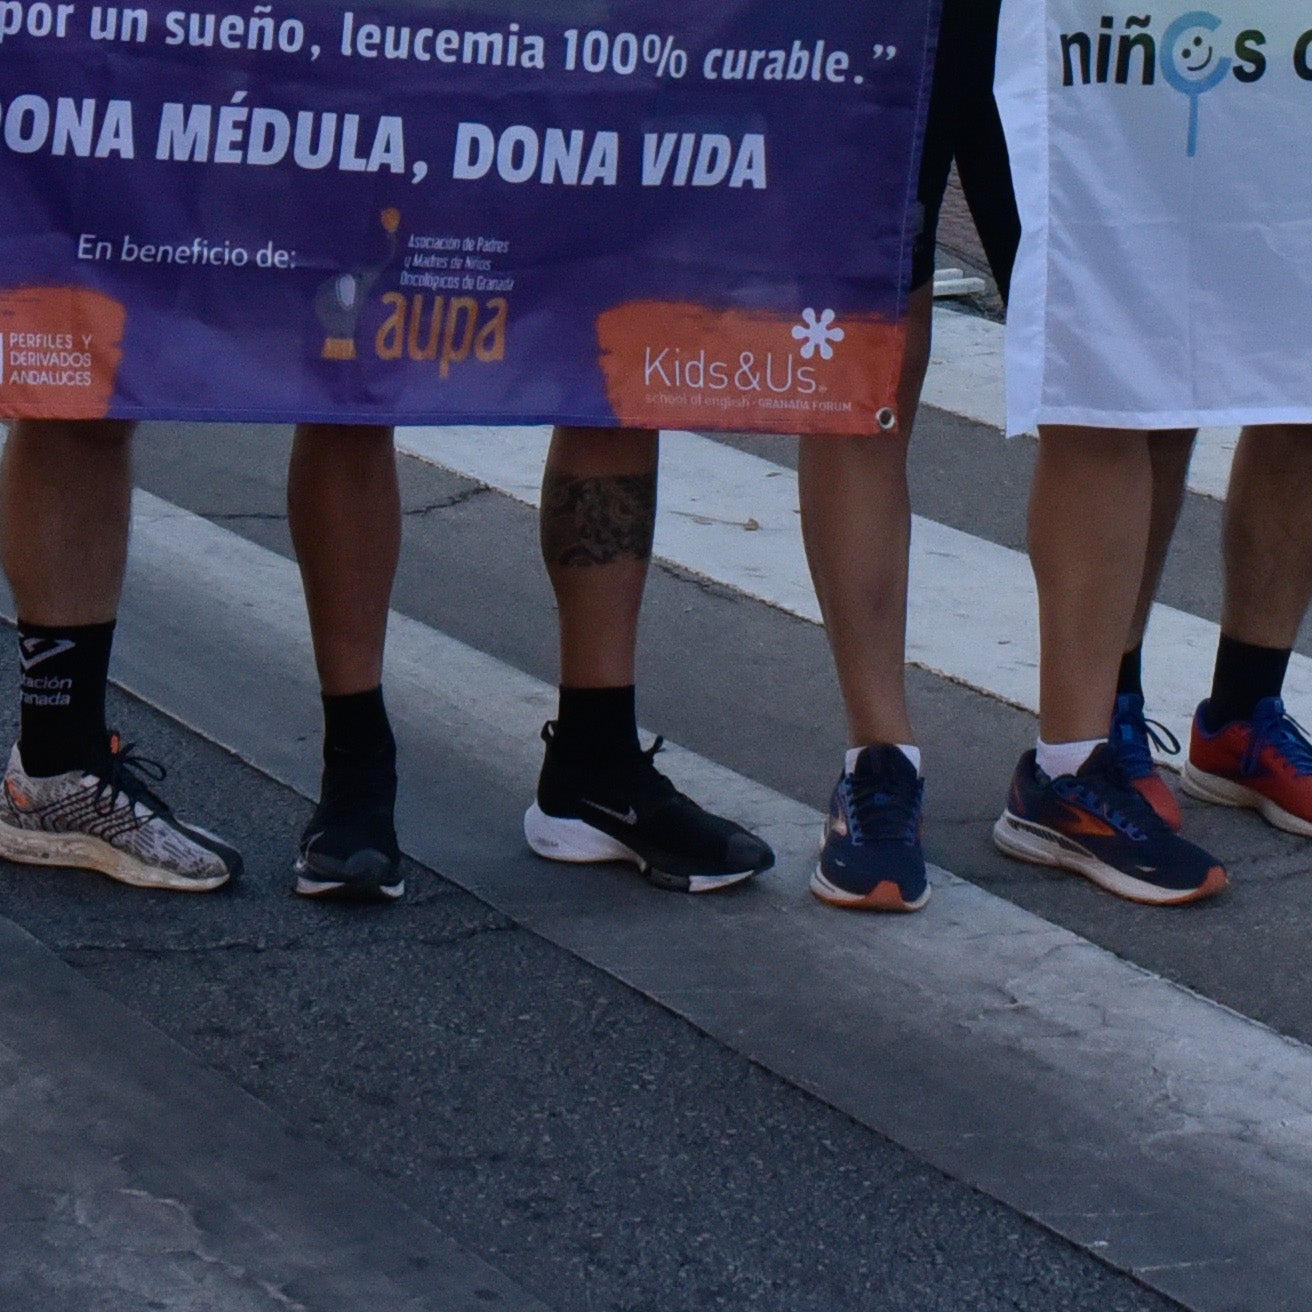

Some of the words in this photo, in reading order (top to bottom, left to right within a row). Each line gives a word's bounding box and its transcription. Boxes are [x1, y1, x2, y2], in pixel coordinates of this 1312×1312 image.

[90, 6, 148, 43] un
[165, 4, 321, 62] sueño,
[341, 11, 544, 70] leucemia
[563, 26, 687, 79] 100%
[156, 90, 429, 184] MÉDULA,
[452, 120, 619, 186] DONA
[641, 130, 767, 190] VIDA
[77, 234, 112, 262] En
[121, 235, 248, 268] beneficio
[256, 240, 296, 270] de:
[408, 234, 460, 251] Asociación
[462, 237, 475, 251] de
[476, 237, 510, 254] Padres
[412, 252, 448, 269] Madres
[450, 255, 463, 269] de
[462, 274, 475, 290] de
[476, 275, 515, 292] Granada
[9, 333, 73, 349] PERFILES
[81, 334, 92, 348] Y
[375, 290, 508, 379] aupa
[9, 351, 93, 368] DERIVADOS
[9, 370, 93, 386] ANDALUCES
[758, 397, 809, 412] GRANADA
[812, 399, 852, 413] FORUM
